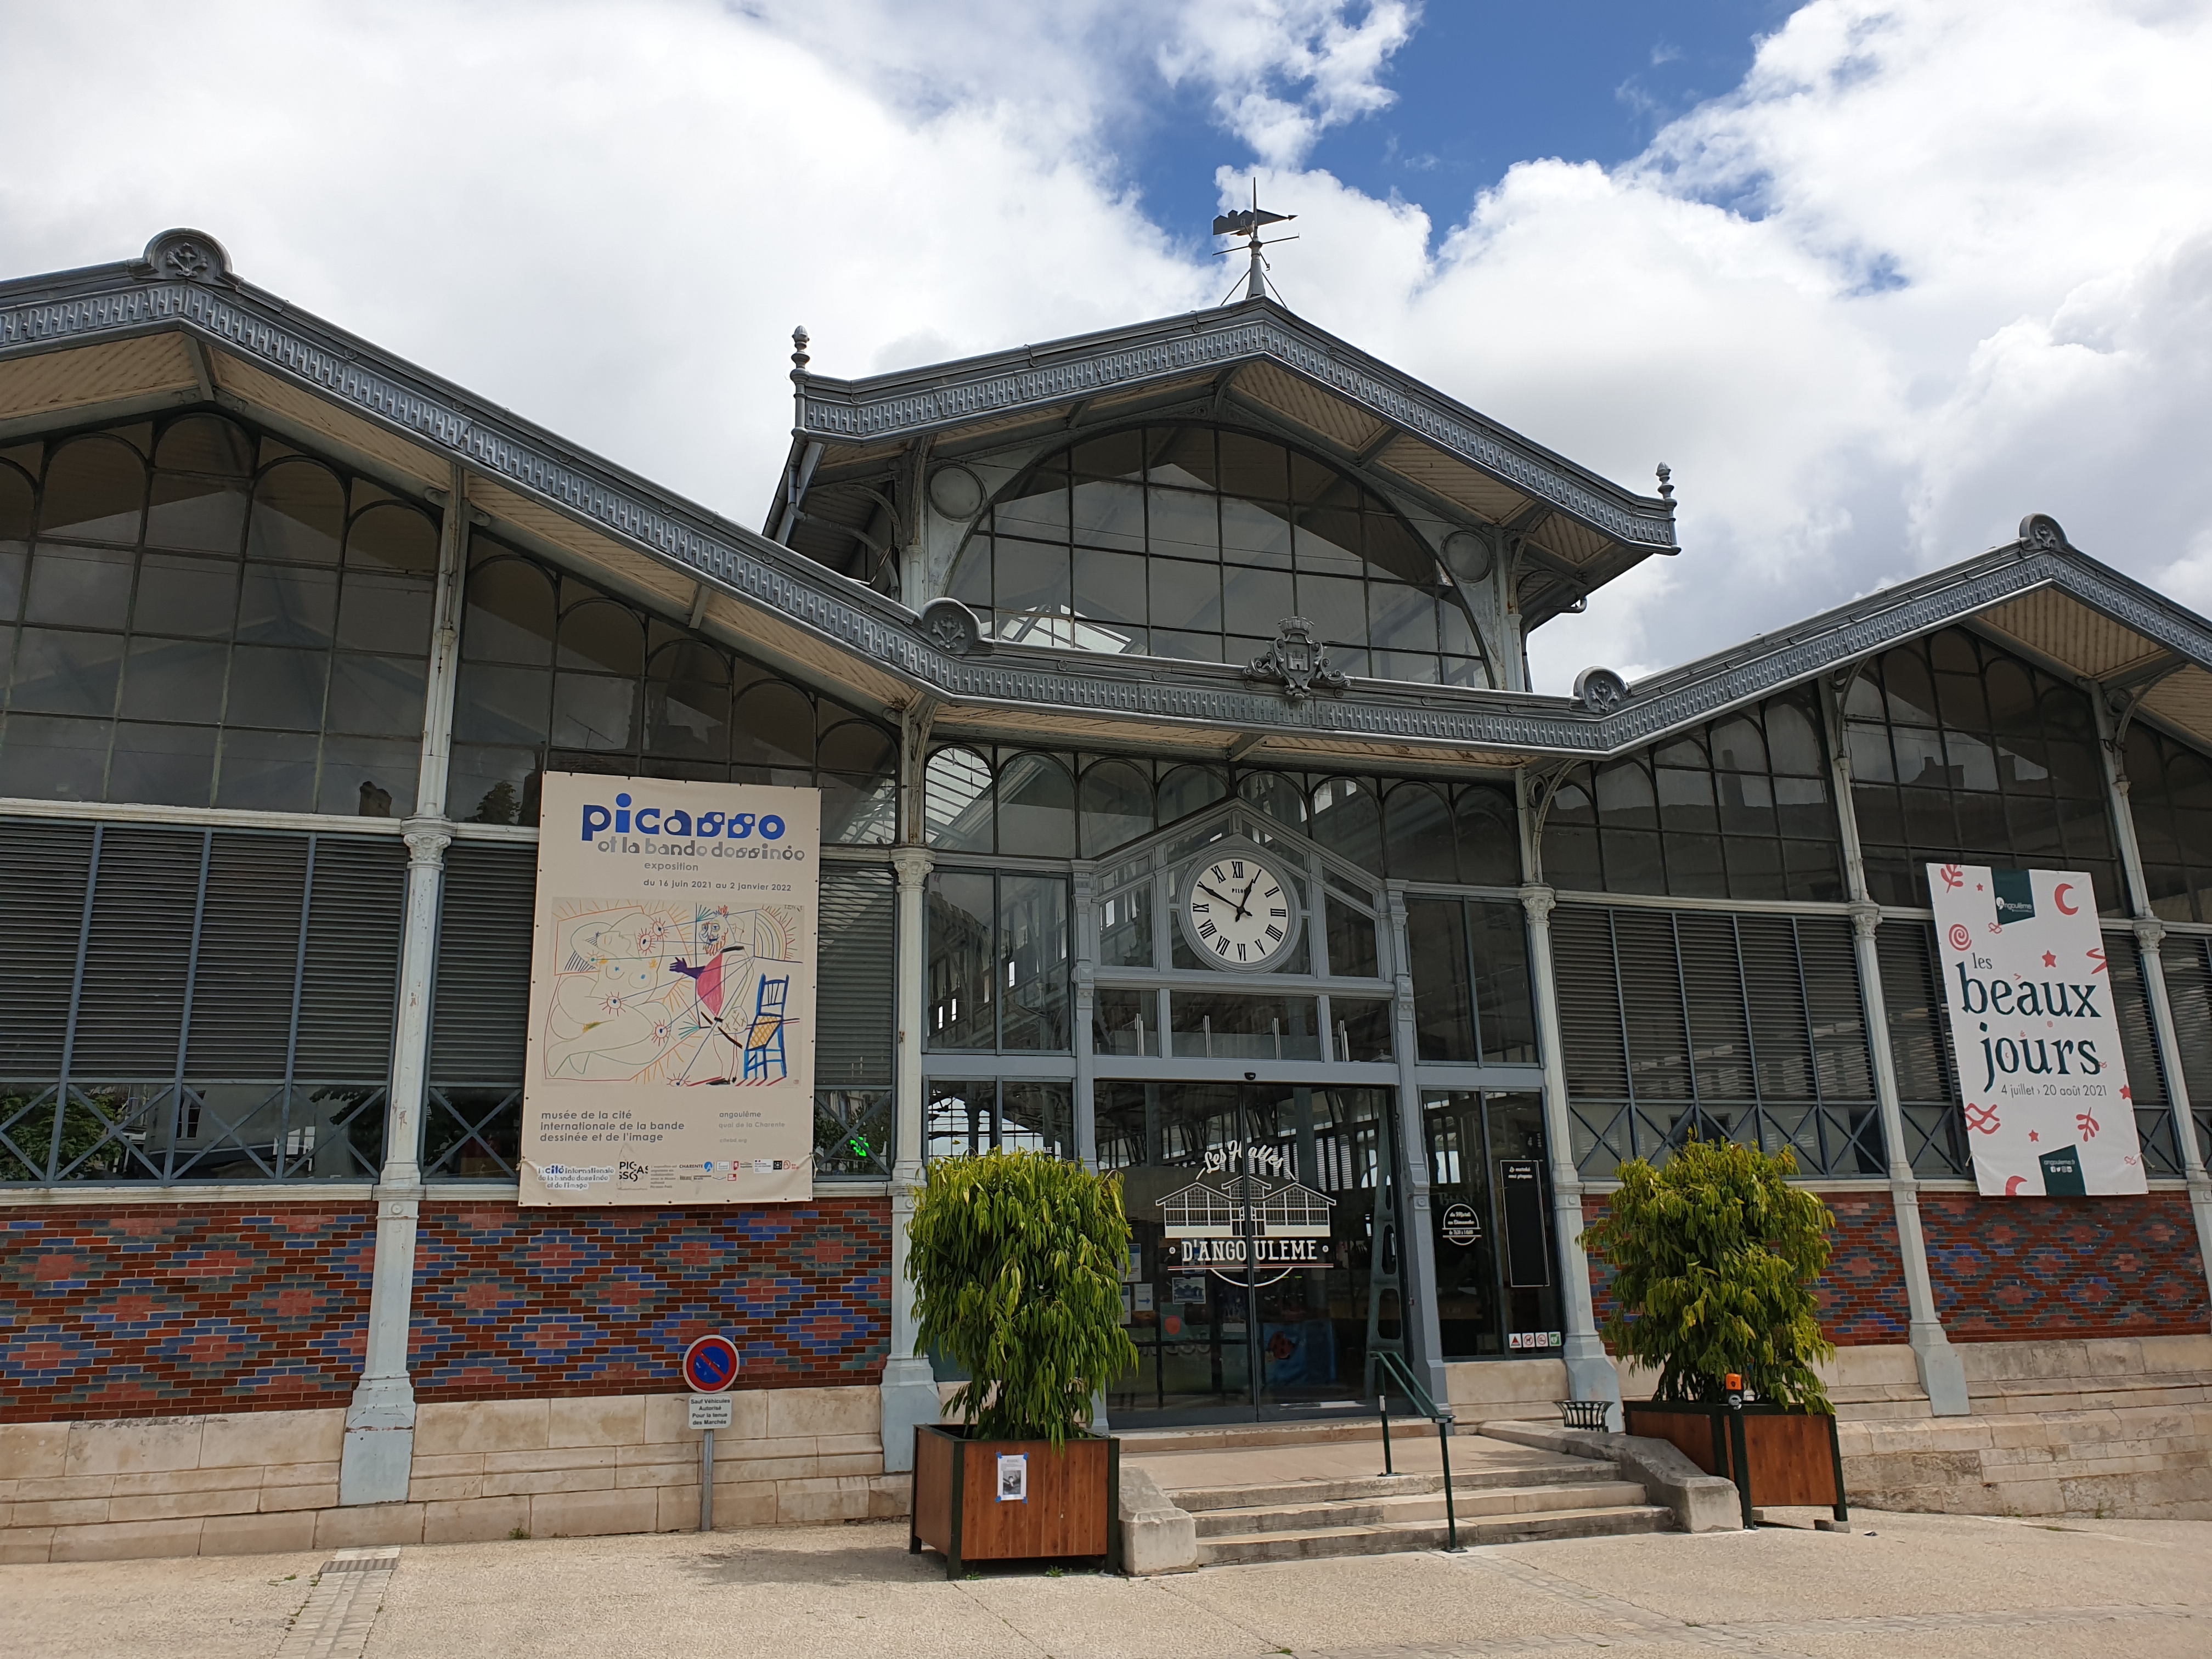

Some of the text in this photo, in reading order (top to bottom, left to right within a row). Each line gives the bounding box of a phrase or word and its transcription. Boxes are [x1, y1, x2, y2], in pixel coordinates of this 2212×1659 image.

[582, 793, 786, 841] picasso
[622, 837, 640, 854] la
[645, 838, 708, 857] bande
[711, 841, 805, 861] dessinée
[644, 862, 699, 871] exposition
[1210, 865, 1226, 884] XI
[1231, 861, 1244, 878] XII
[672, 880, 689, 888] juin
[737, 882, 769, 890] janvier
[1270, 909, 1286, 917] III
[1215, 935, 1231, 956] VII
[1237, 944, 1246, 961] VI
[1254, 939, 1266, 955] V
[1972, 952, 1993, 969] les
[1955, 961, 2102, 1018] beaux
[1979, 1022, 2101, 1093] jours
[2001, 1083, 2107, 1098] 4 juillet 20 août 2021
[541, 1110, 632, 1119] musée de la cité
[540, 1121, 685, 1130] internationale de la bande
[540, 1132, 663, 1143] dessinée et de l'image
[1204, 1139, 1284, 1173] Les Halles
